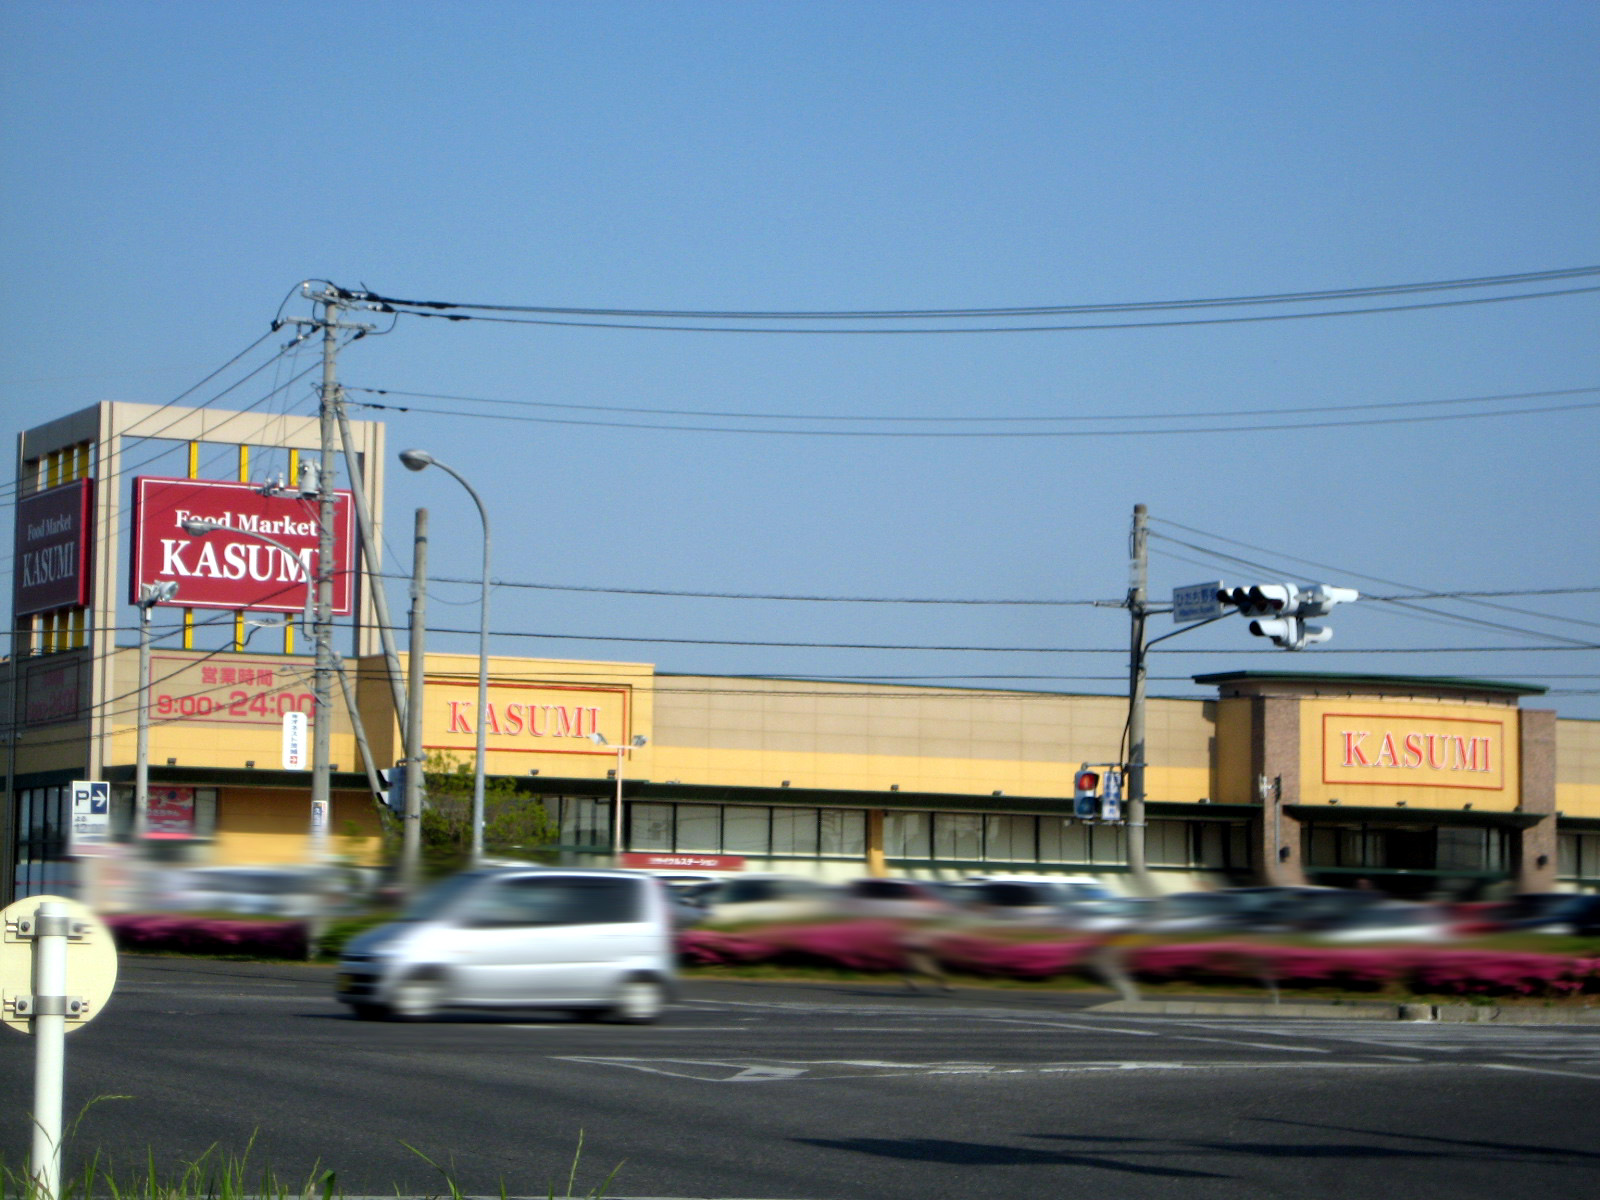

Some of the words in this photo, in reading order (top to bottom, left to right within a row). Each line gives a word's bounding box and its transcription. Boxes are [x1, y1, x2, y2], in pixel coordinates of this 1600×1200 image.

[27, 520, 45, 541] Food
[46, 513, 72, 536] Market
[236, 513, 319, 537] Market
[23, 542, 74, 587] KASUMI
[160, 538, 320, 583] KASUM
[201, 666, 274, 687] 営業時間
[157, 694, 212, 717] 9:00
[228, 690, 315, 719] 24:00
[447, 701, 602, 739] KASUMI
[1342, 730, 1493, 772] KASUMI
[75, 790, 89, 806] P
